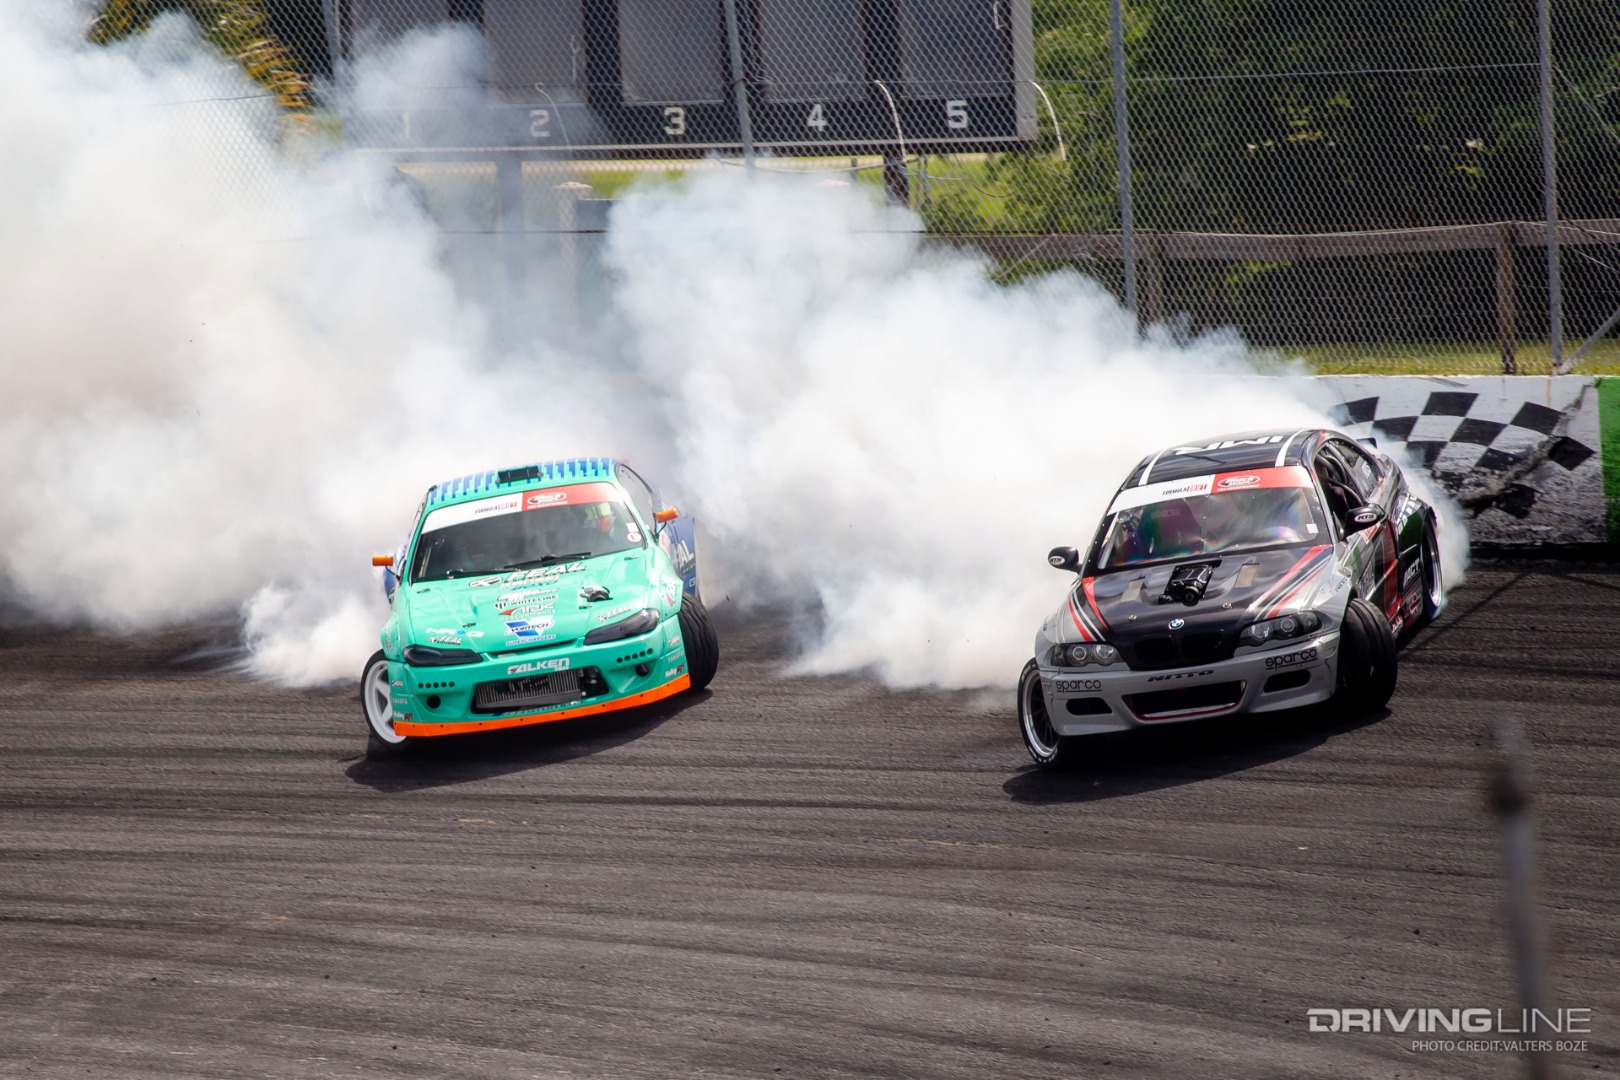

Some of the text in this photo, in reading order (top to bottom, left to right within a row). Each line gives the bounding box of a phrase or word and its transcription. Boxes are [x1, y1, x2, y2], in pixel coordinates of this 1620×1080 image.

[529, 109, 550, 137] 2
[664, 107, 685, 134] 3
[807, 104, 828, 131] 4
[947, 100, 968, 128] 5
[504, 562, 587, 583] FEAL
[510, 595, 557, 606] WHITELINE
[507, 657, 570, 675] FALKEN
[1265, 648, 1318, 670] sparco
[1148, 669, 1215, 683] NITTO
[1055, 679, 1102, 694] sparco
